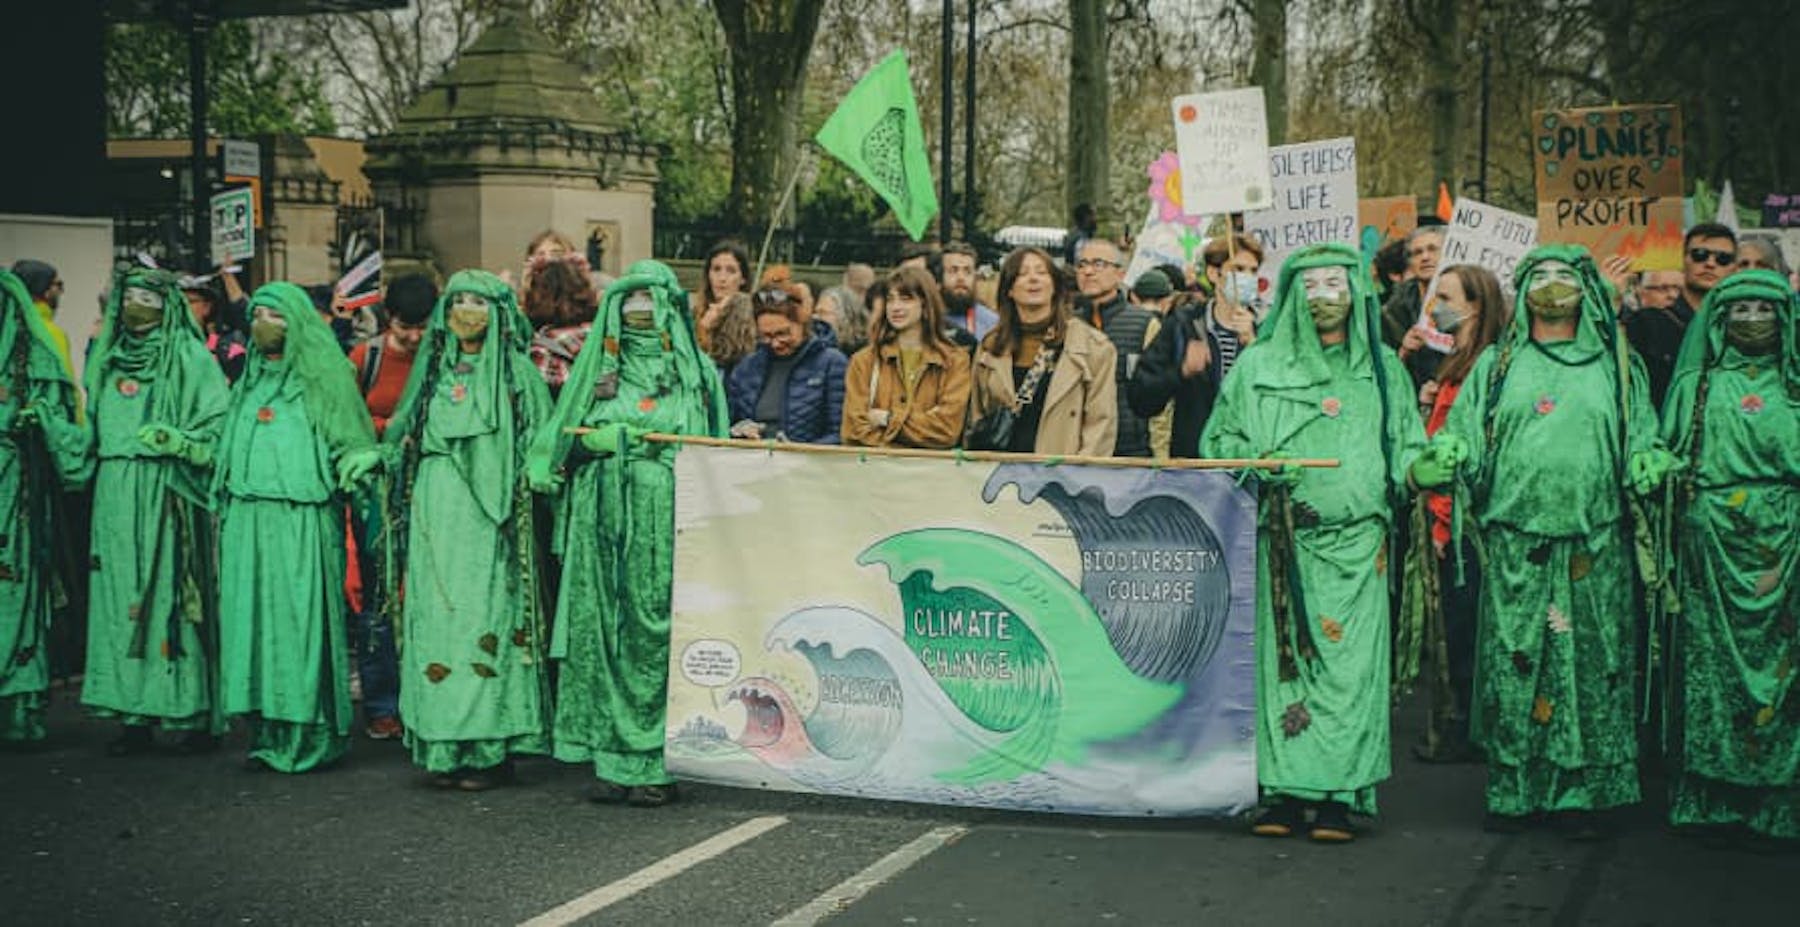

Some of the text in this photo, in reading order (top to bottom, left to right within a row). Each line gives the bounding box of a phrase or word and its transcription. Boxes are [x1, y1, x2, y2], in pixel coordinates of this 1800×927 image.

[1558, 123, 1670, 160] PLANET
[1573, 165, 1645, 191] OVER
[1287, 183, 1332, 210] LIFE
[1457, 207, 1482, 228] NO
[1556, 195, 1661, 230] PROFIT
[1445, 237, 1468, 259] IN
[1083, 549, 1219, 572] BIODIVERSITY
[1107, 579, 1196, 604] COLLAPSE
[914, 608, 1012, 639] CLIMATE
[921, 646, 1012, 679] CHANGE
